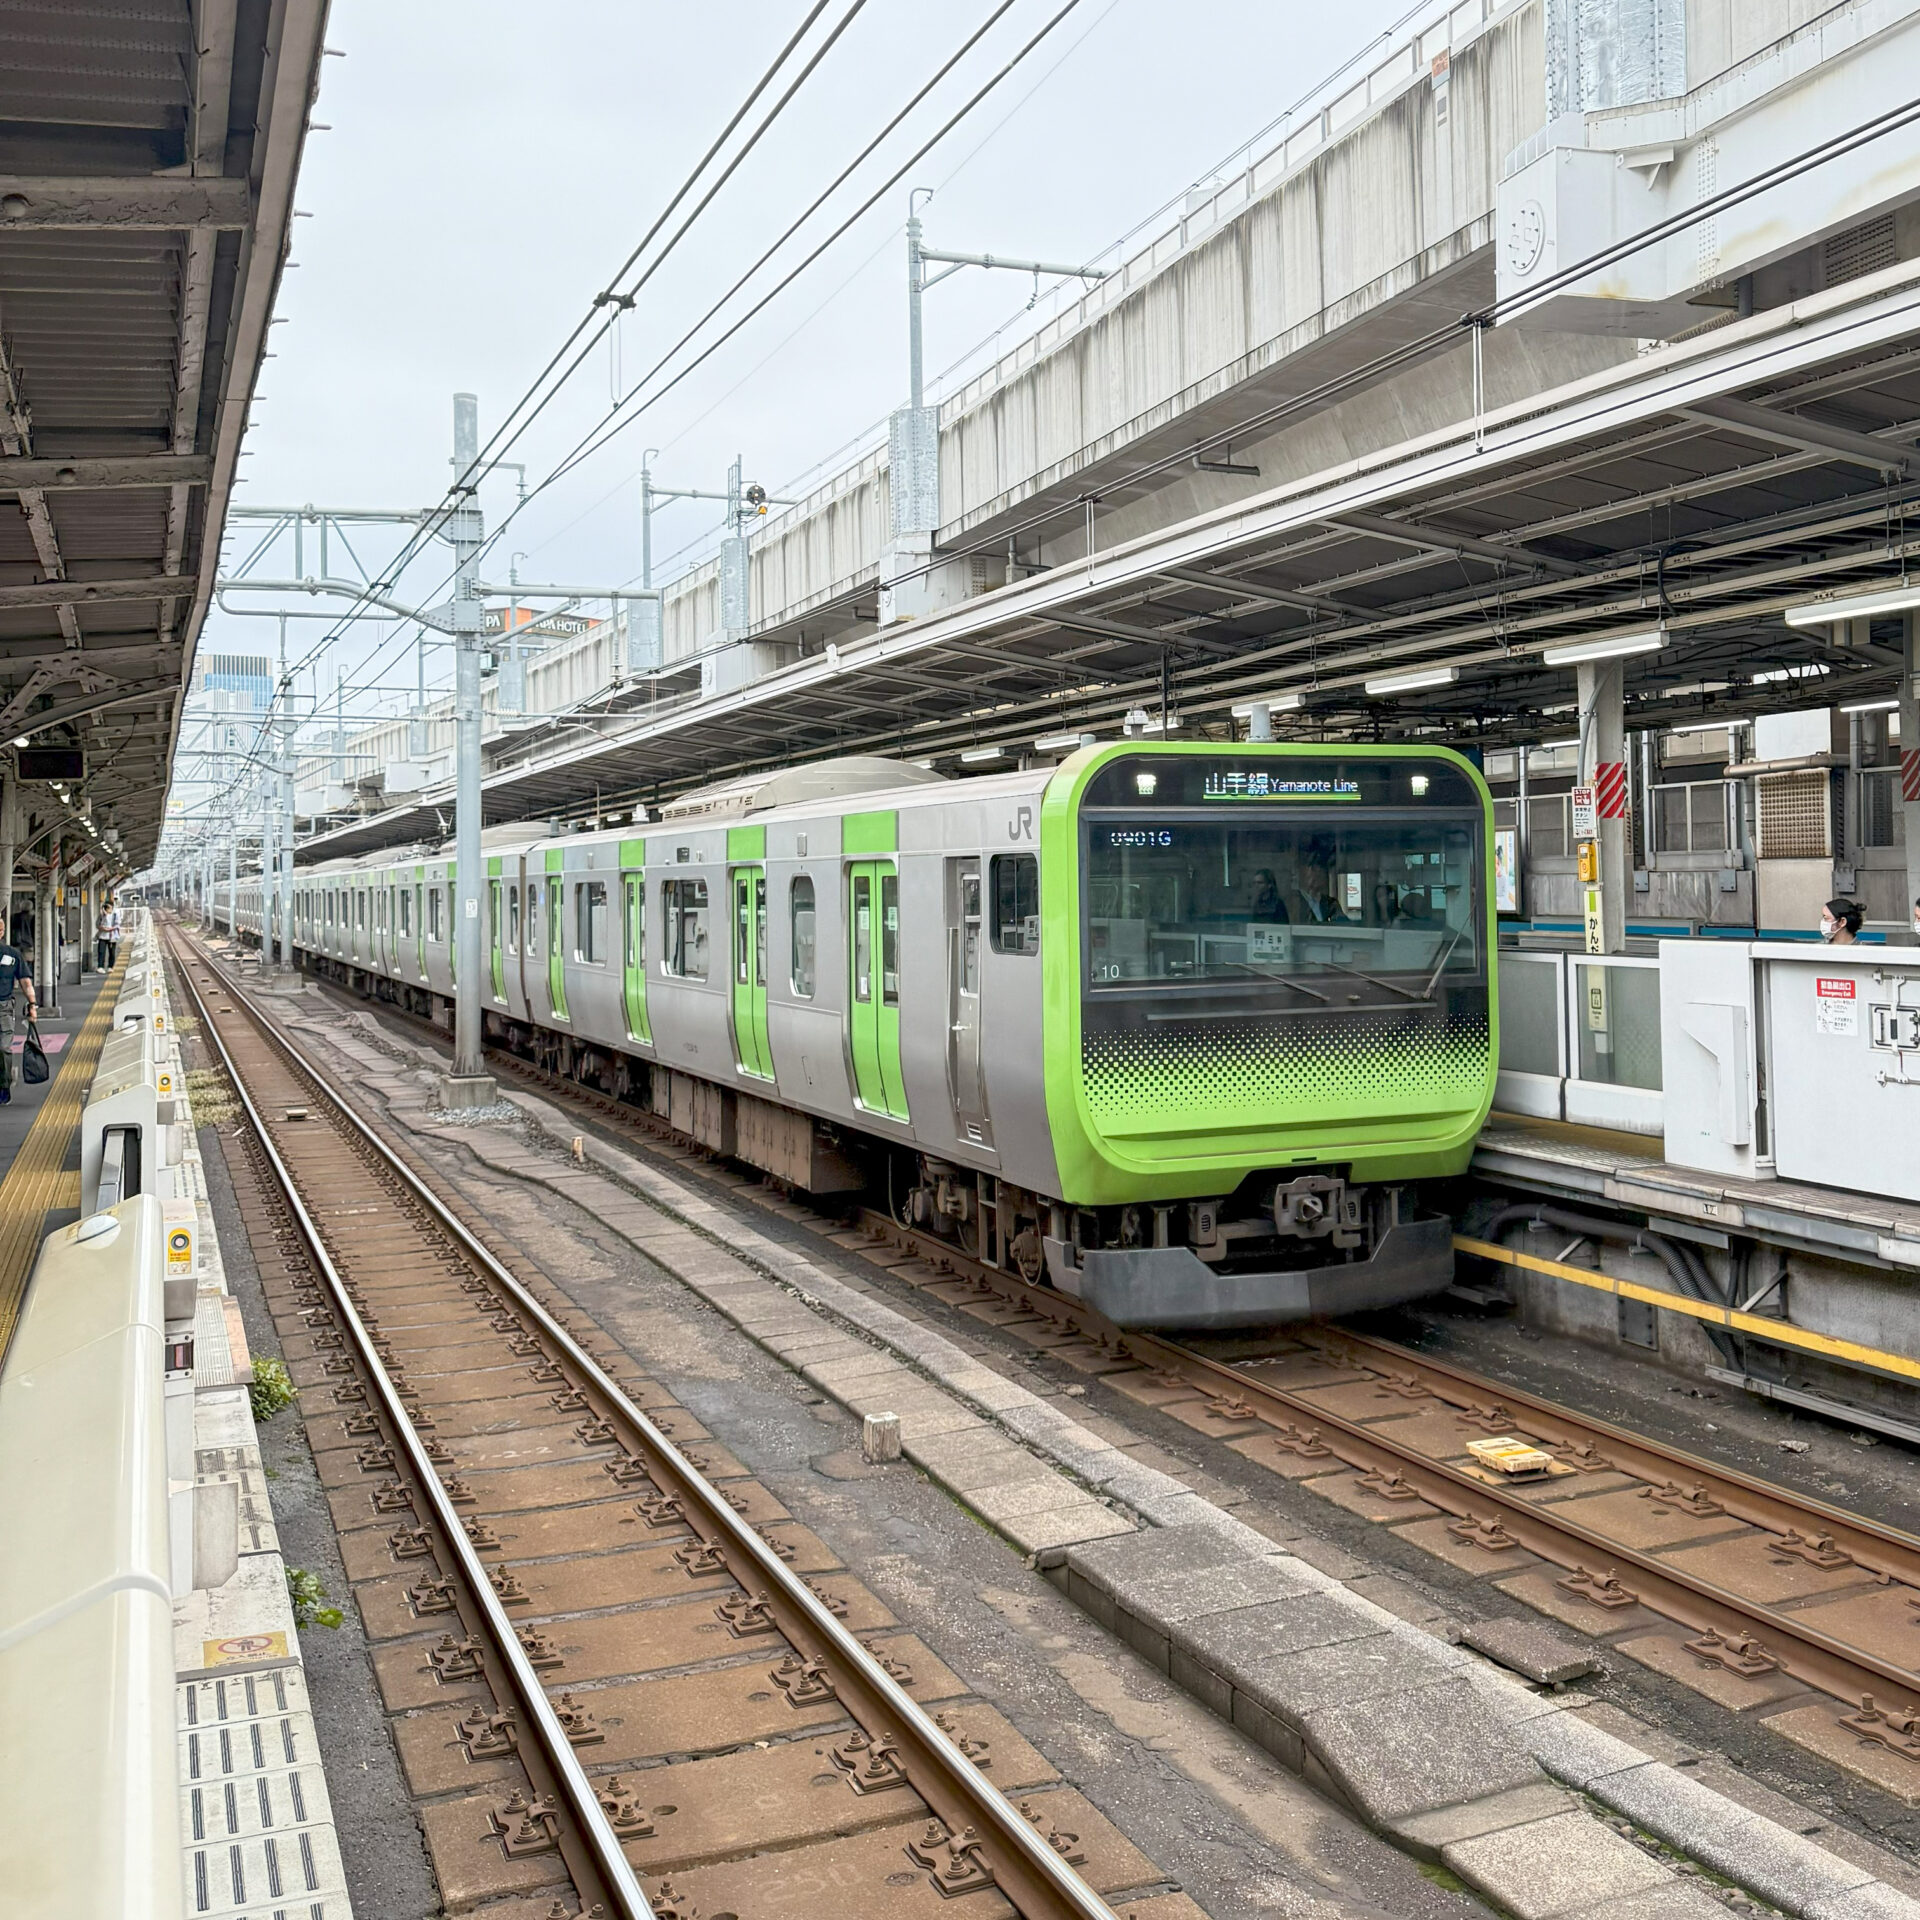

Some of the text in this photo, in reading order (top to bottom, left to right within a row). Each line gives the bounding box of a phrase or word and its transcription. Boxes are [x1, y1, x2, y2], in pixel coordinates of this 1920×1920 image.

[486, 615, 501, 628] PA
[556, 619, 586, 634] HOTEL
[1205, 772, 1269, 796] 山手線
[1270, 778, 1359, 792] Yamanote Line
[1009, 806, 1032, 840] JR
[1111, 831, 1171, 846] 0901G
[1101, 964, 1120, 979] 10
